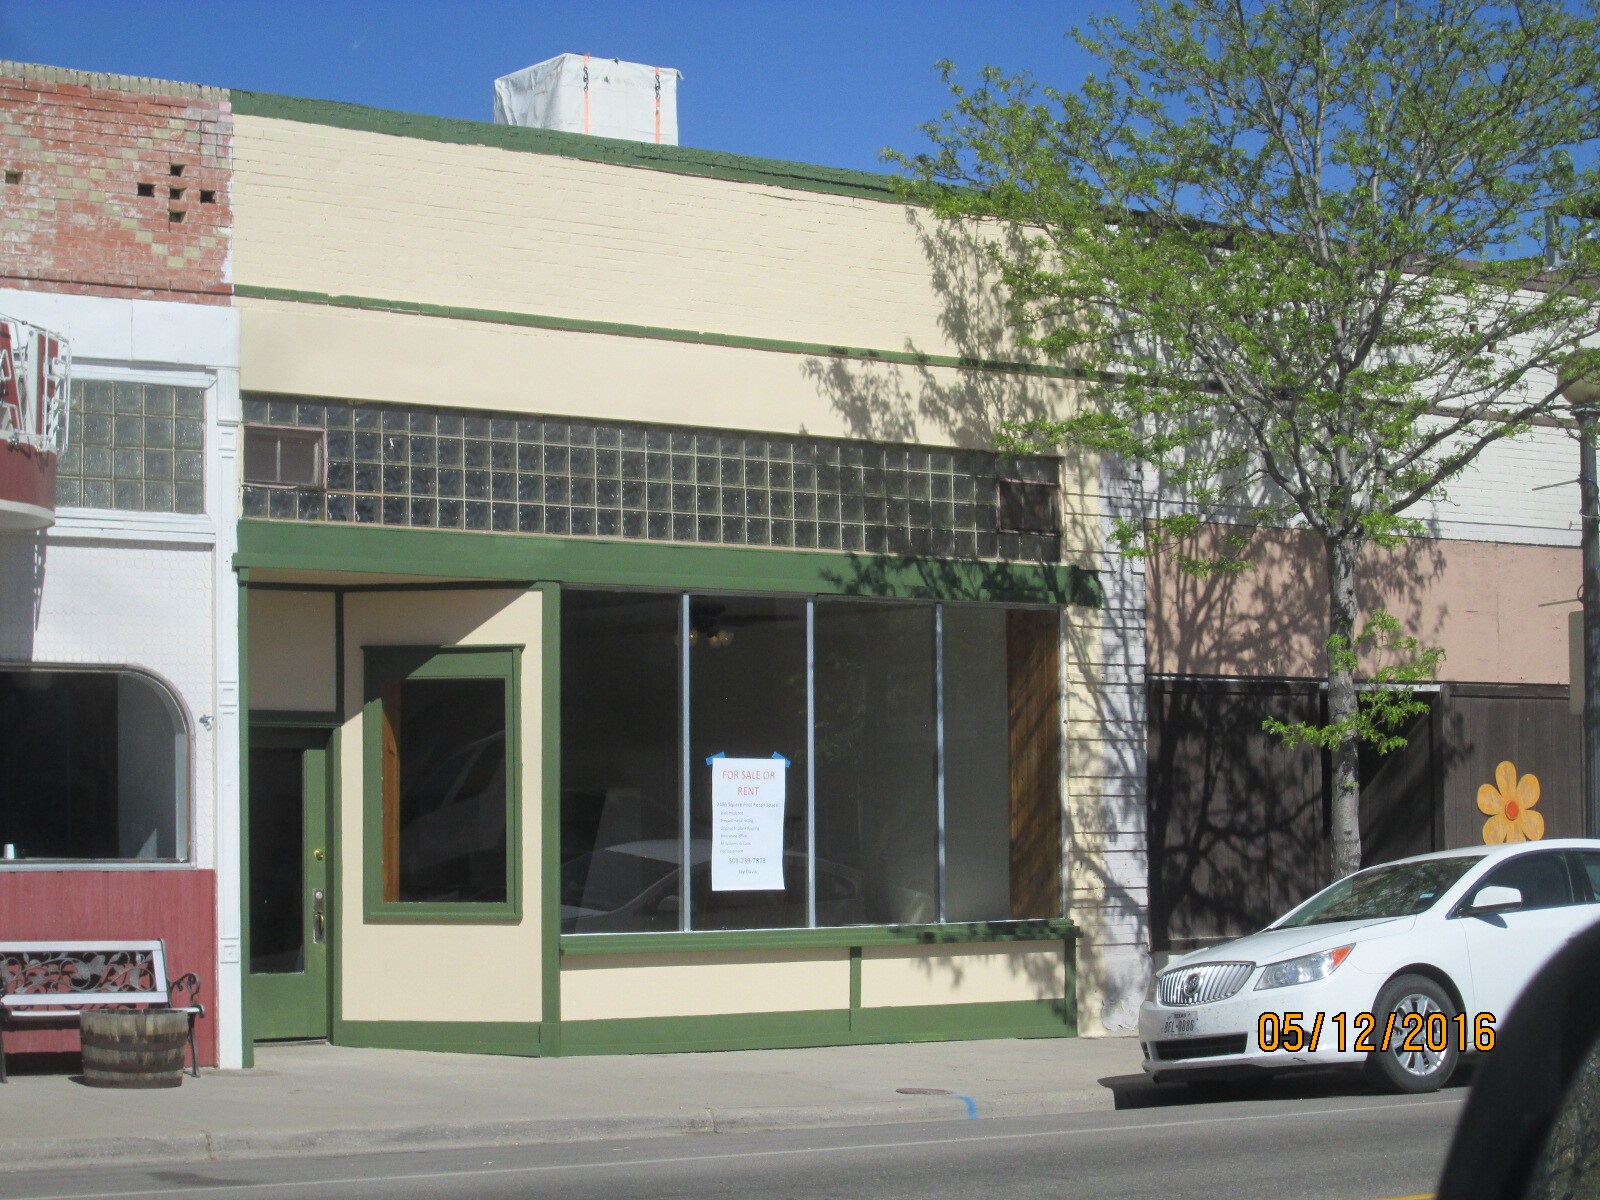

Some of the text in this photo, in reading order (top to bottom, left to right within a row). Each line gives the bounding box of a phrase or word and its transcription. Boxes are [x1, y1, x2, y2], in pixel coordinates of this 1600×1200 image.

[722, 770, 776, 780] FOR SALE OR
[737, 786, 760, 796] RENT
